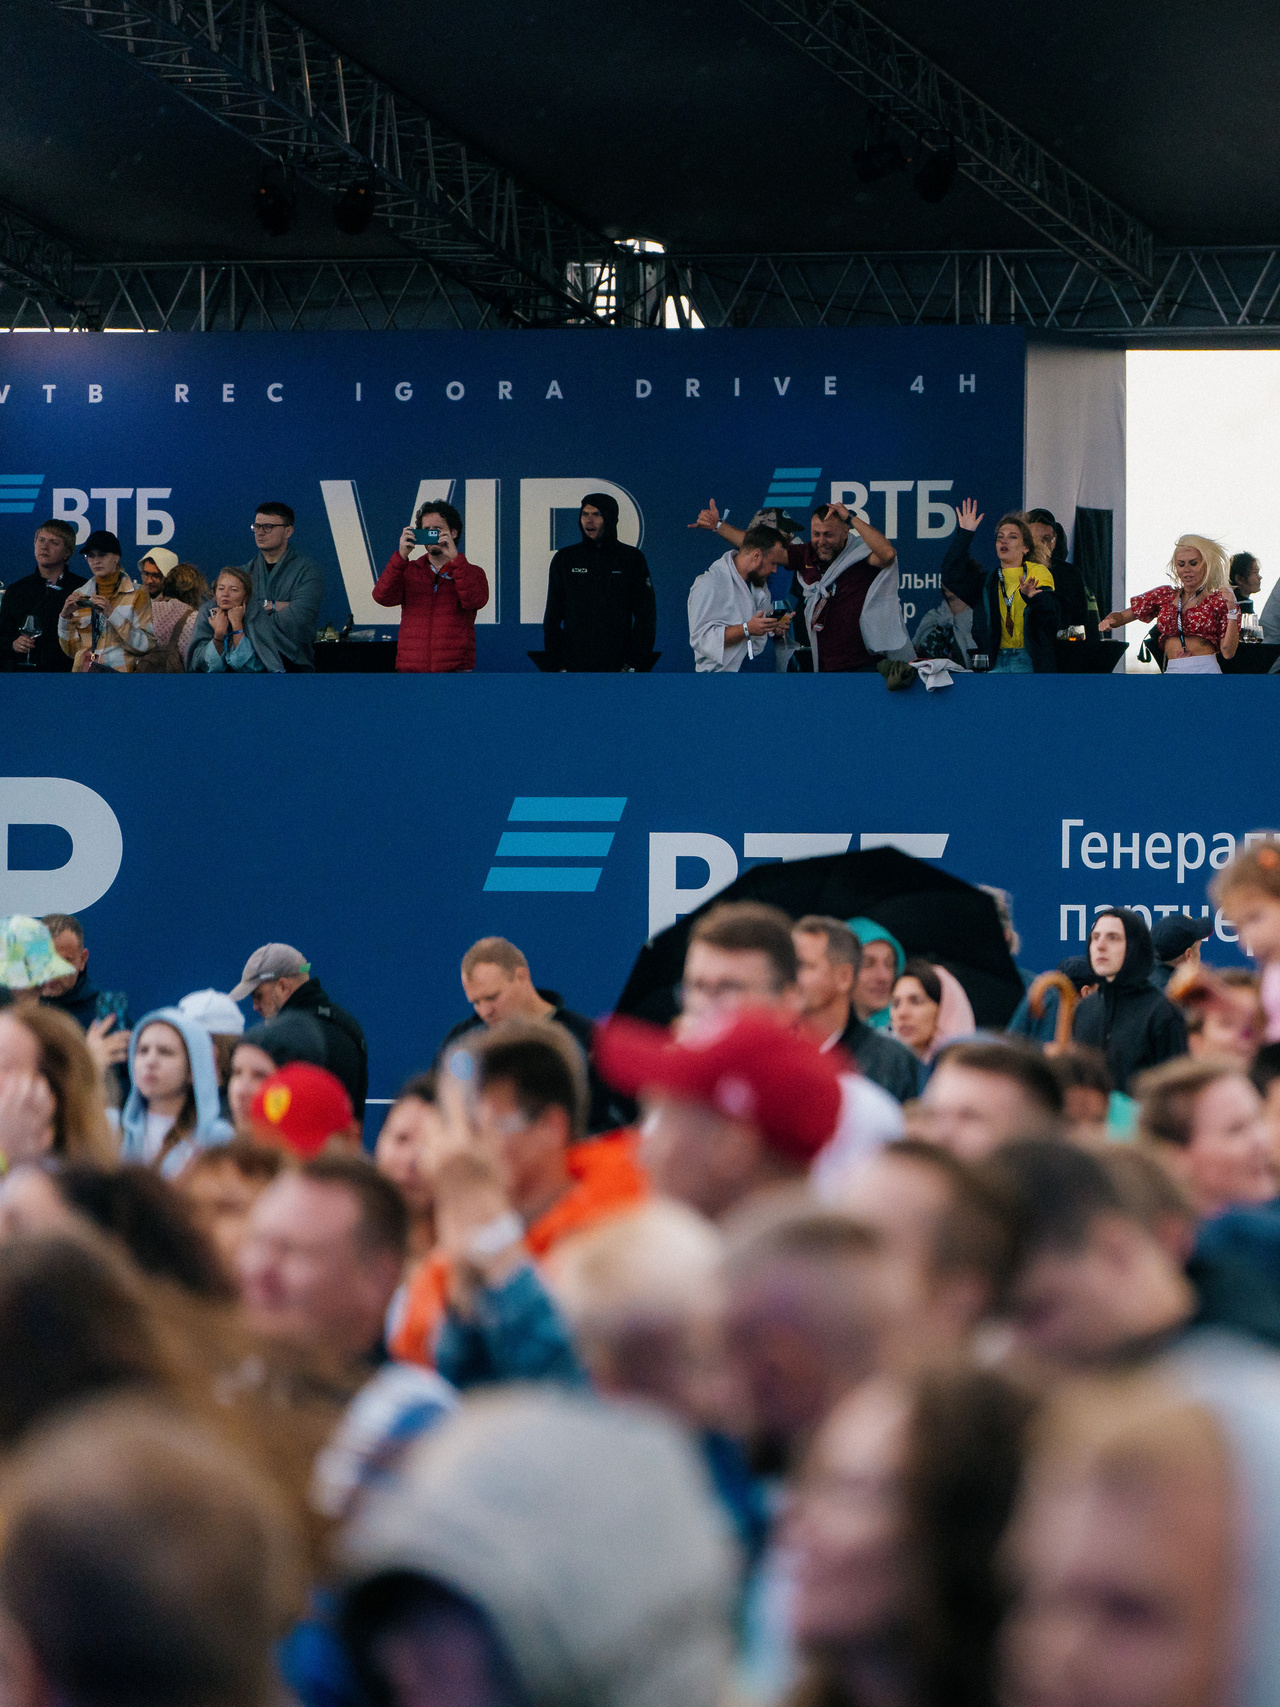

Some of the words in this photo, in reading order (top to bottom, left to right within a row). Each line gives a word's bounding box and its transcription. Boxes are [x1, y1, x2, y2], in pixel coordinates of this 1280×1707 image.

[174, 382, 284, 403] REC
[356, 380, 563, 402] IGORA
[636, 376, 837, 398] DRIVE
[910, 374, 975, 393] 4H
[52, 487, 176, 546] ВТБ
[830, 479, 957, 540] ВТБ
[319, 477, 646, 625] VIP
